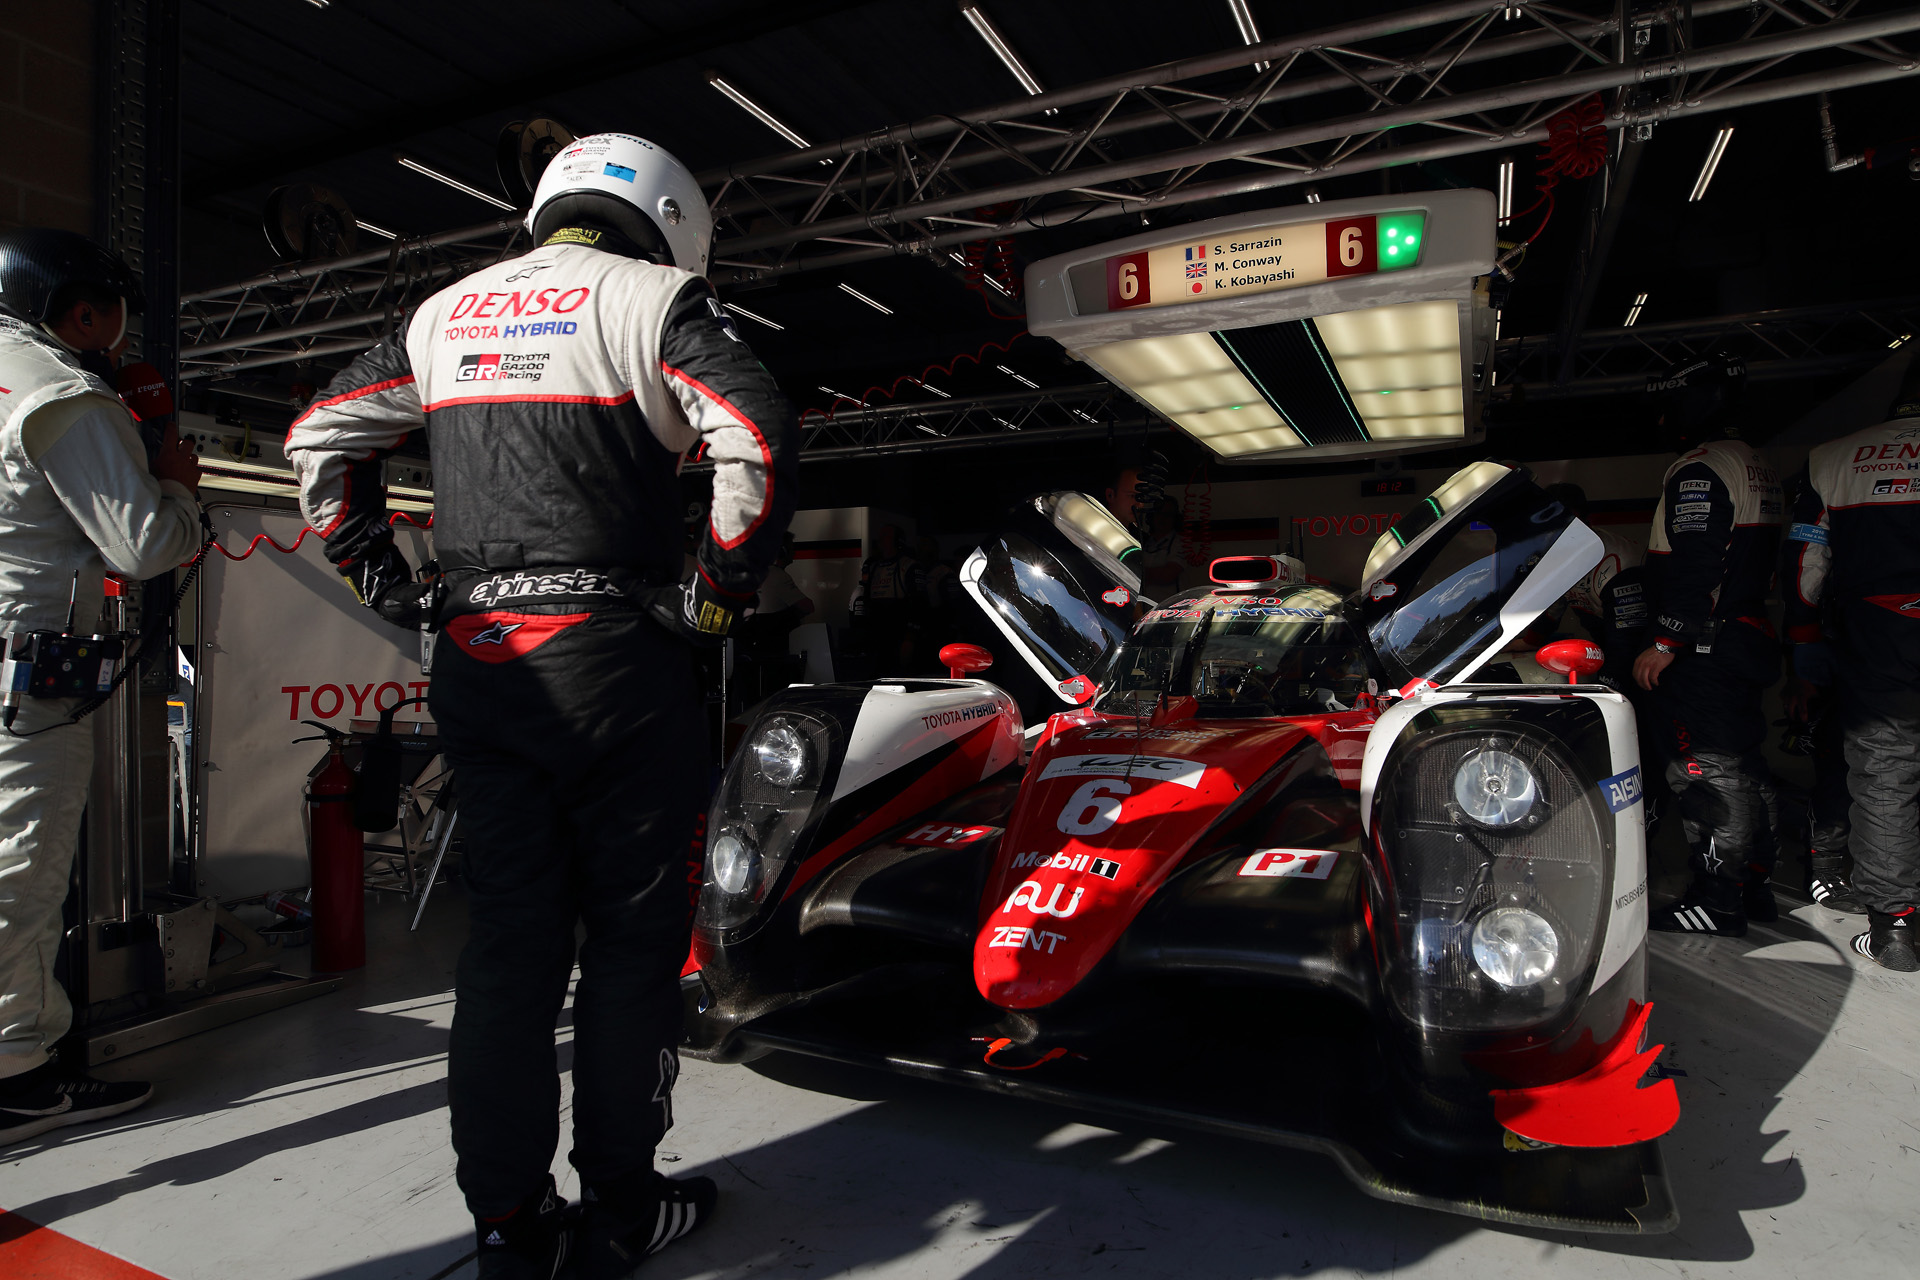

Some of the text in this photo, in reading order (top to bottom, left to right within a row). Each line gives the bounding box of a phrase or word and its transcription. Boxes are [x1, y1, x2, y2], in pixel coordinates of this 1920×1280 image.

[1213, 236, 1283, 256] S. Sarrazin
[1338, 226, 1364, 267] 6
[1214, 253, 1282, 273] M. Conway
[1118, 262, 1139, 301] 6
[1214, 268, 1296, 290] K. Kobayashi
[449, 287, 590, 322] DENSO
[445, 321, 578, 342] TOYOTA HYBRID
[501, 361, 545, 371] GAZOO
[503, 353, 550, 362] TOYOTA
[457, 362, 499, 381] GR
[499, 371, 542, 382] Racing
[1646, 376, 1688, 393] uvex
[1852, 462, 1905, 474] TOYOTA
[1873, 484, 1909, 495] GR
[1292, 513, 1402, 537] TOYOTA
[1216, 607, 1327, 620] HYBRID
[281, 681, 430, 720] TOYOT
[921, 710, 962, 731] TOYOTA
[961, 702, 997, 721] HYBRID
[1079, 756, 1184, 771] WEC
[1609, 772, 1642, 806] AISIN
[1056, 778, 1132, 836] 6
[905, 824, 984, 844] HY
[1011, 851, 1090, 872] Mobil
[1255, 852, 1322, 874] P1
[988, 926, 1067, 955] ZENT
